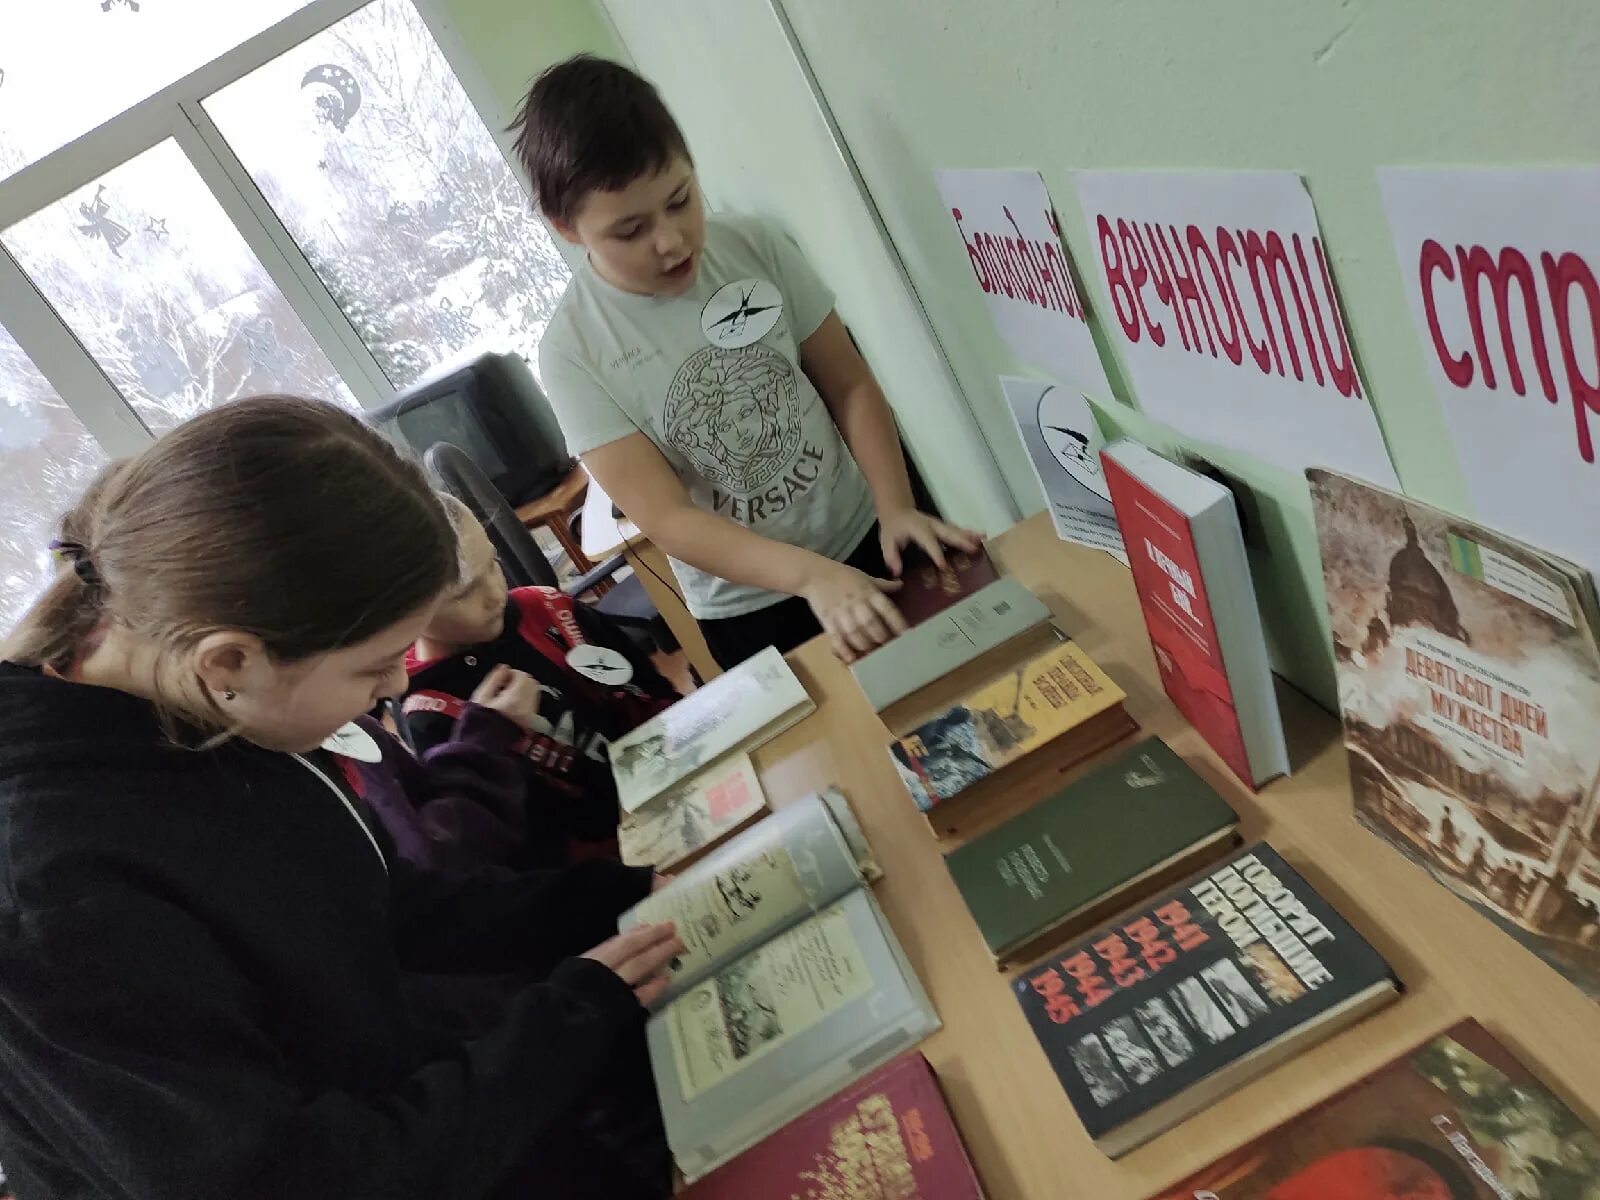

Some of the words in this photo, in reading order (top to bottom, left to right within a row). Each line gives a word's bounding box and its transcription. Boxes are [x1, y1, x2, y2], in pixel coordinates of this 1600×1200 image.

[1096, 213, 1363, 399] вечности
[711, 440, 824, 524] VERSACE
[1405, 646, 1493, 712] ДЕВЯТЬСОТ
[1500, 689, 1549, 739] ДНЕЙ
[1430, 687, 1525, 759] МУЖЕСТВА
[1210, 865, 1335, 991] ПОГИБШИЕ
[1232, 853, 1336, 946] ГОВОРЯТ
